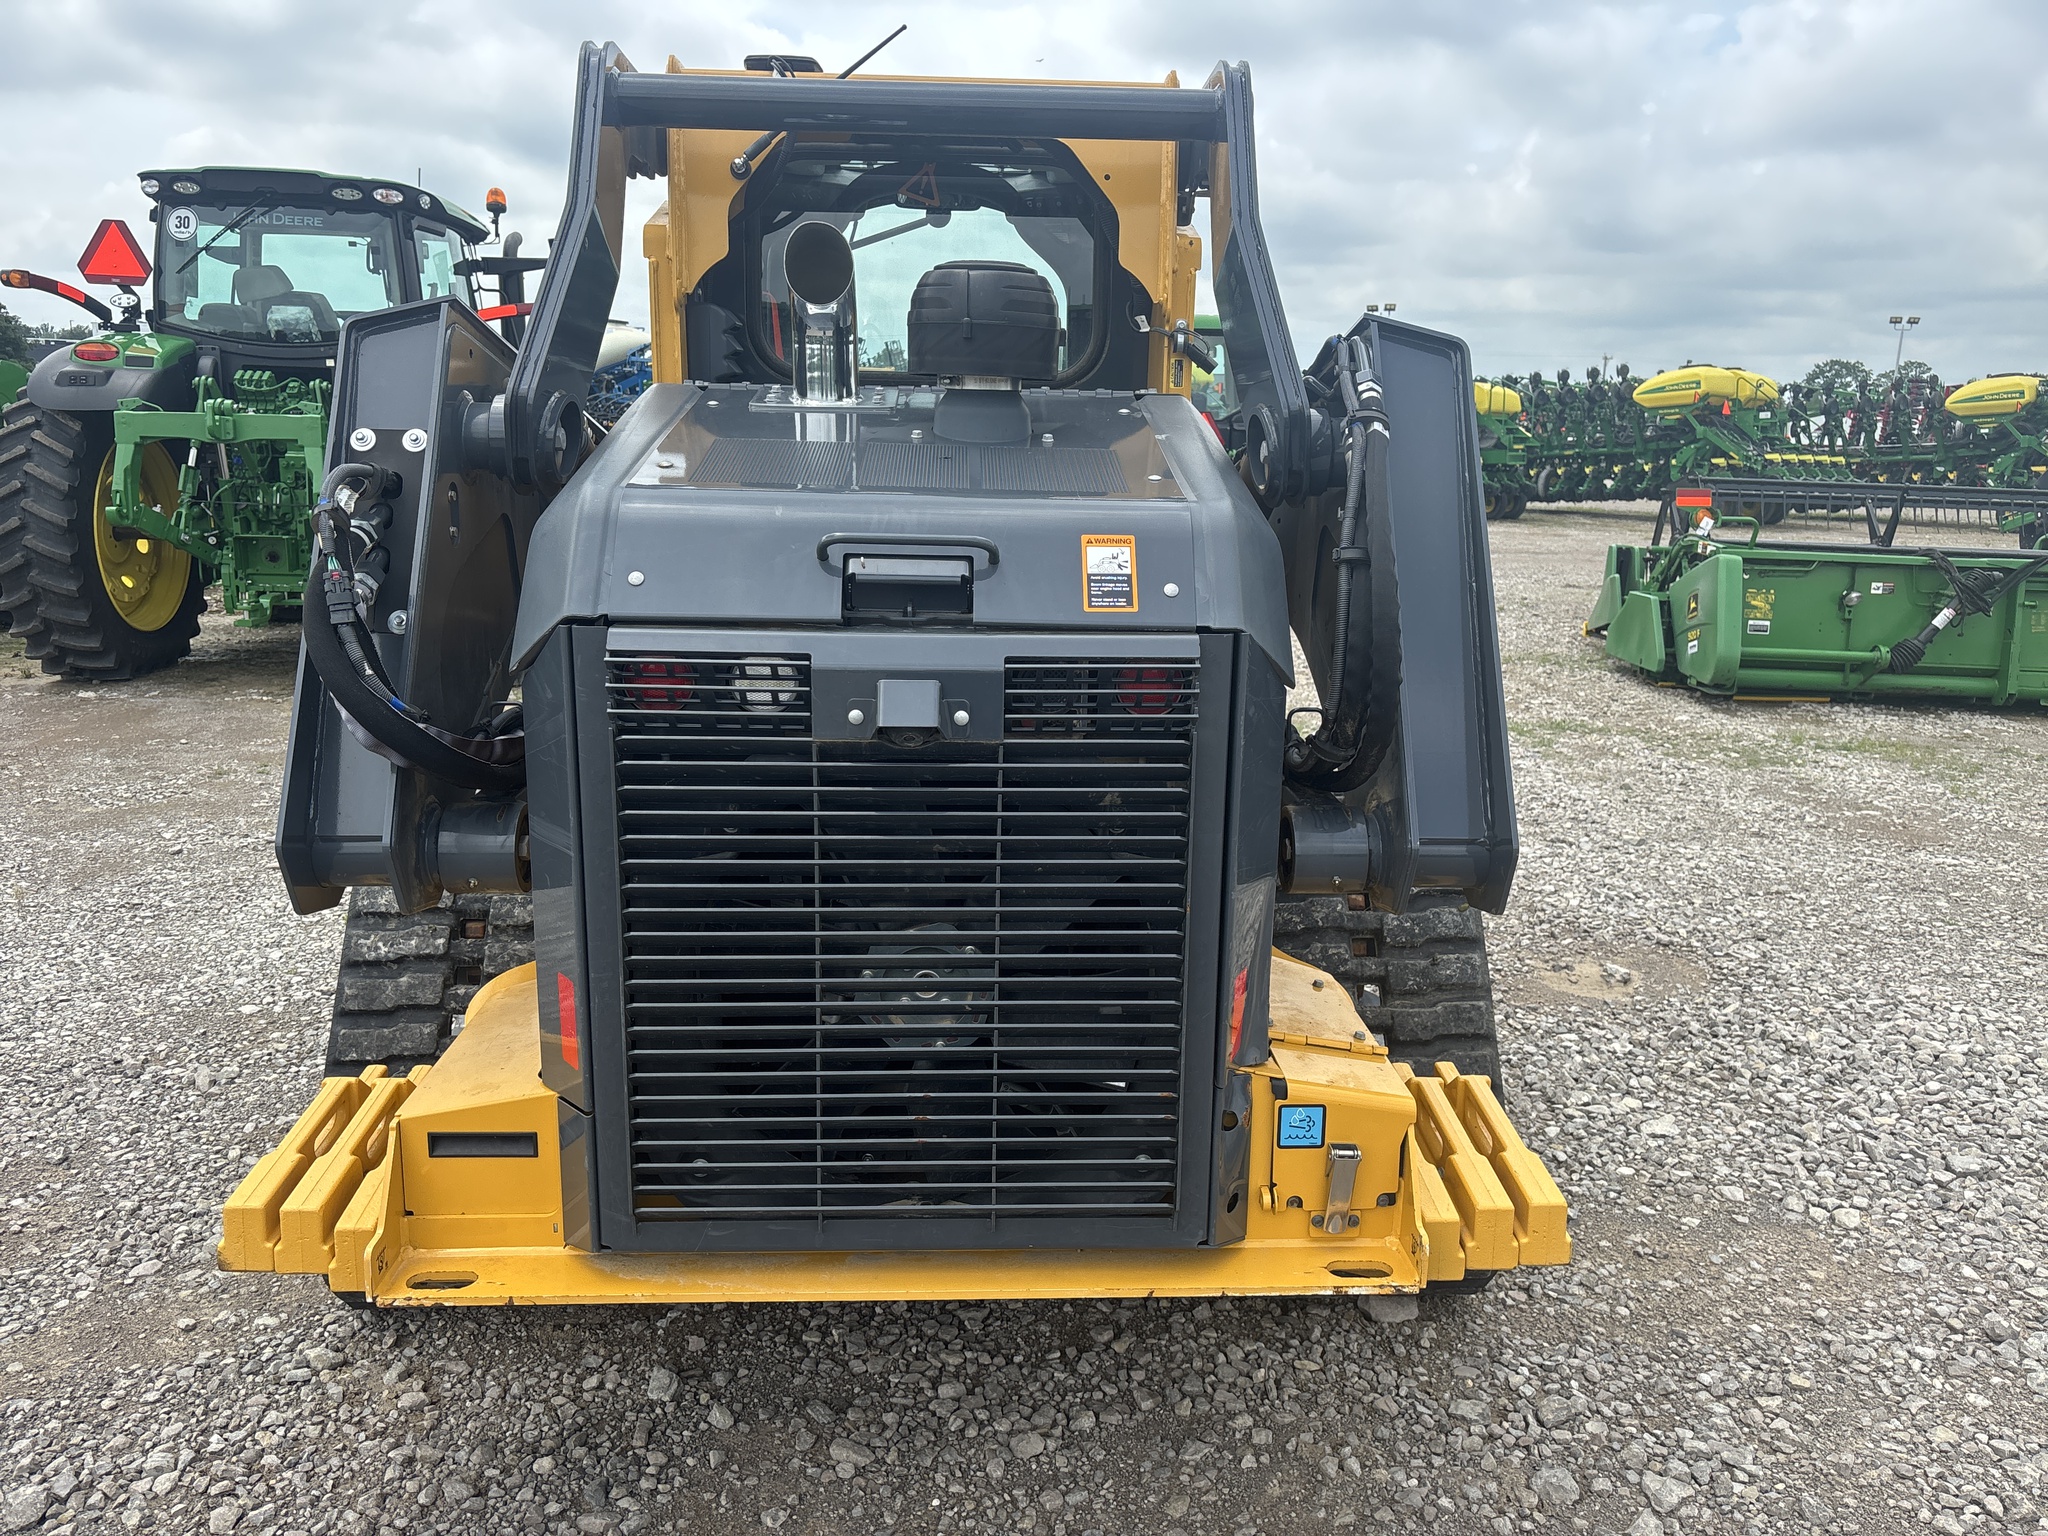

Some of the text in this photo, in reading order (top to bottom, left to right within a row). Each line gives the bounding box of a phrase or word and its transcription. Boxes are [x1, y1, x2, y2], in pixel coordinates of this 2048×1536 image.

[175, 215, 190, 230] 30
[228, 211, 324, 227] JHN DEERE
[1094, 537, 1132, 545] WARNING
